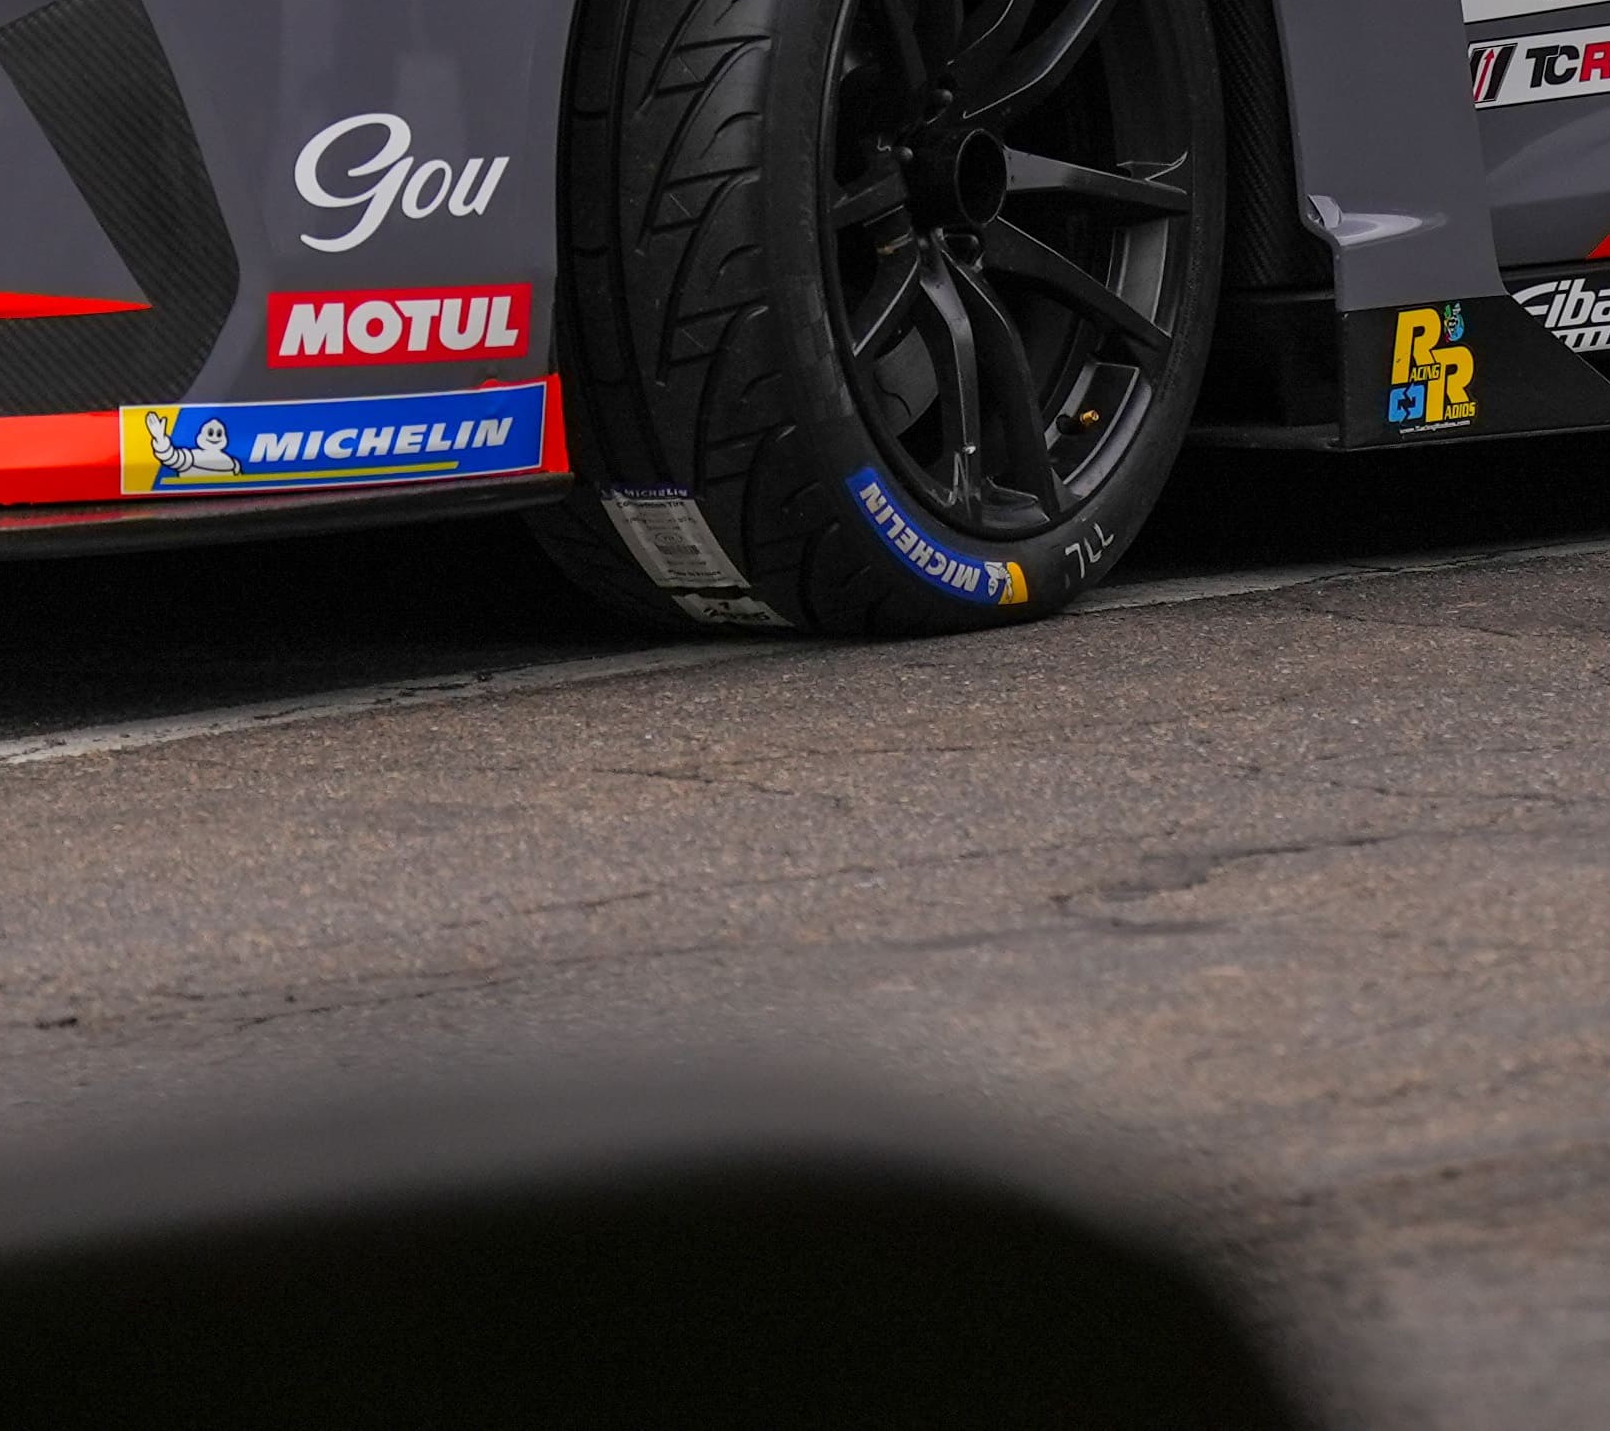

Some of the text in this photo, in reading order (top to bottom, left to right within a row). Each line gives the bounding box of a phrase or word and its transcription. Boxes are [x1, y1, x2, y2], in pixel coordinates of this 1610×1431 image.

[277, 295, 520, 358] MOTUL
[248, 417, 514, 464] MICHELIN
[859, 480, 982, 594] MICHELIN
